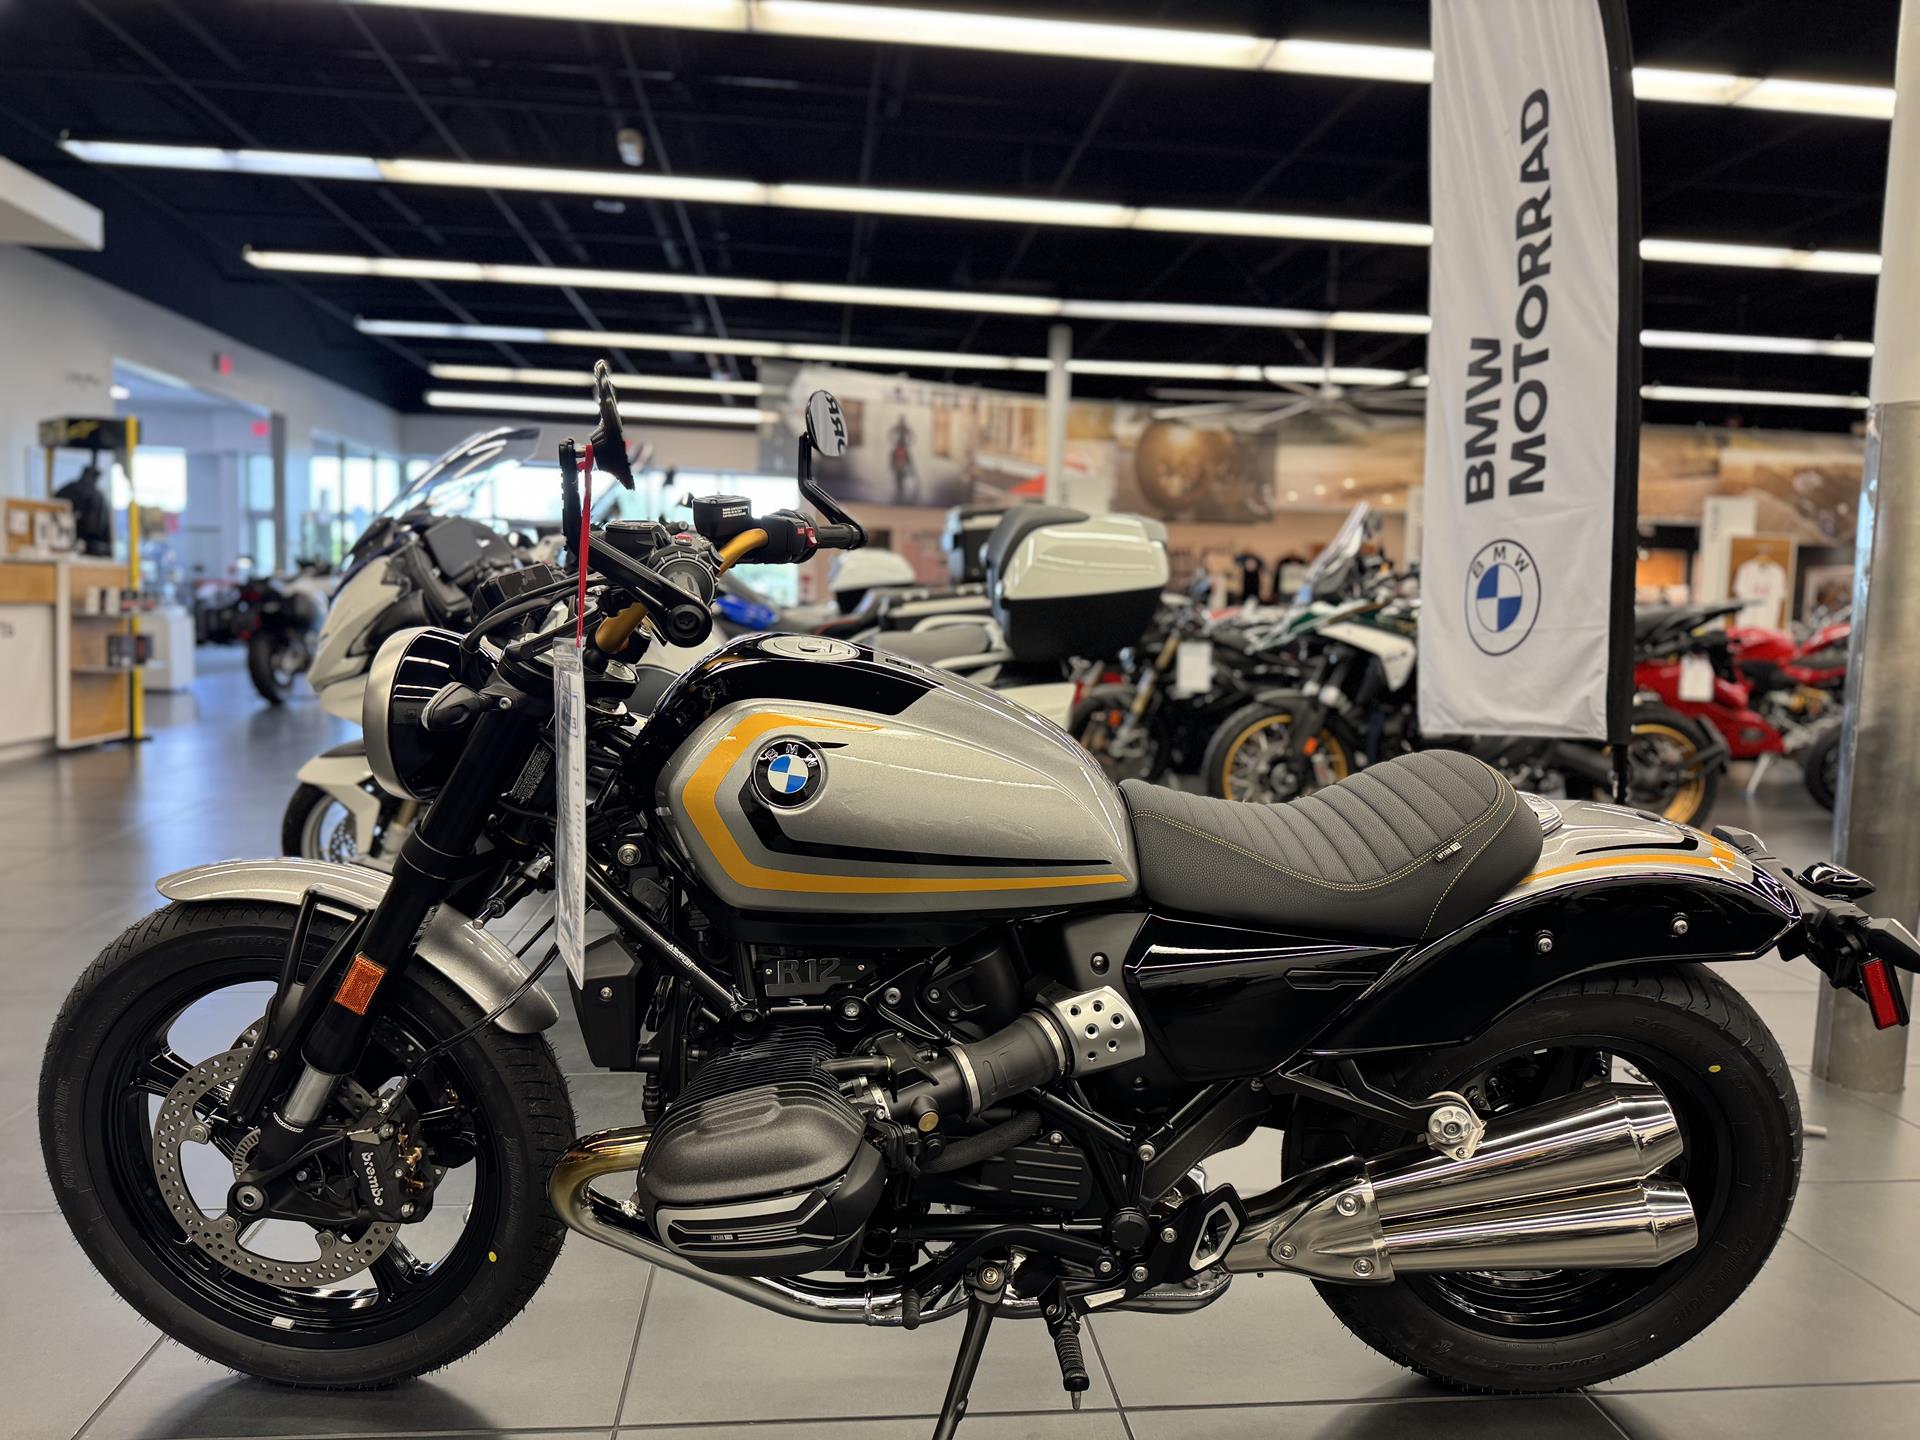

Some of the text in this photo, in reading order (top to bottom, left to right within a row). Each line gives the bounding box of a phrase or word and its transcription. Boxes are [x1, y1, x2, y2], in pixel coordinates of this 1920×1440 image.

[1508, 88, 1552, 496] MOTORRAD
[1465, 338, 1502, 505] BMW
[1471, 546, 1530, 579] BMW
[765, 743, 818, 768] BMW
[361, 1151, 384, 1206] brembo
